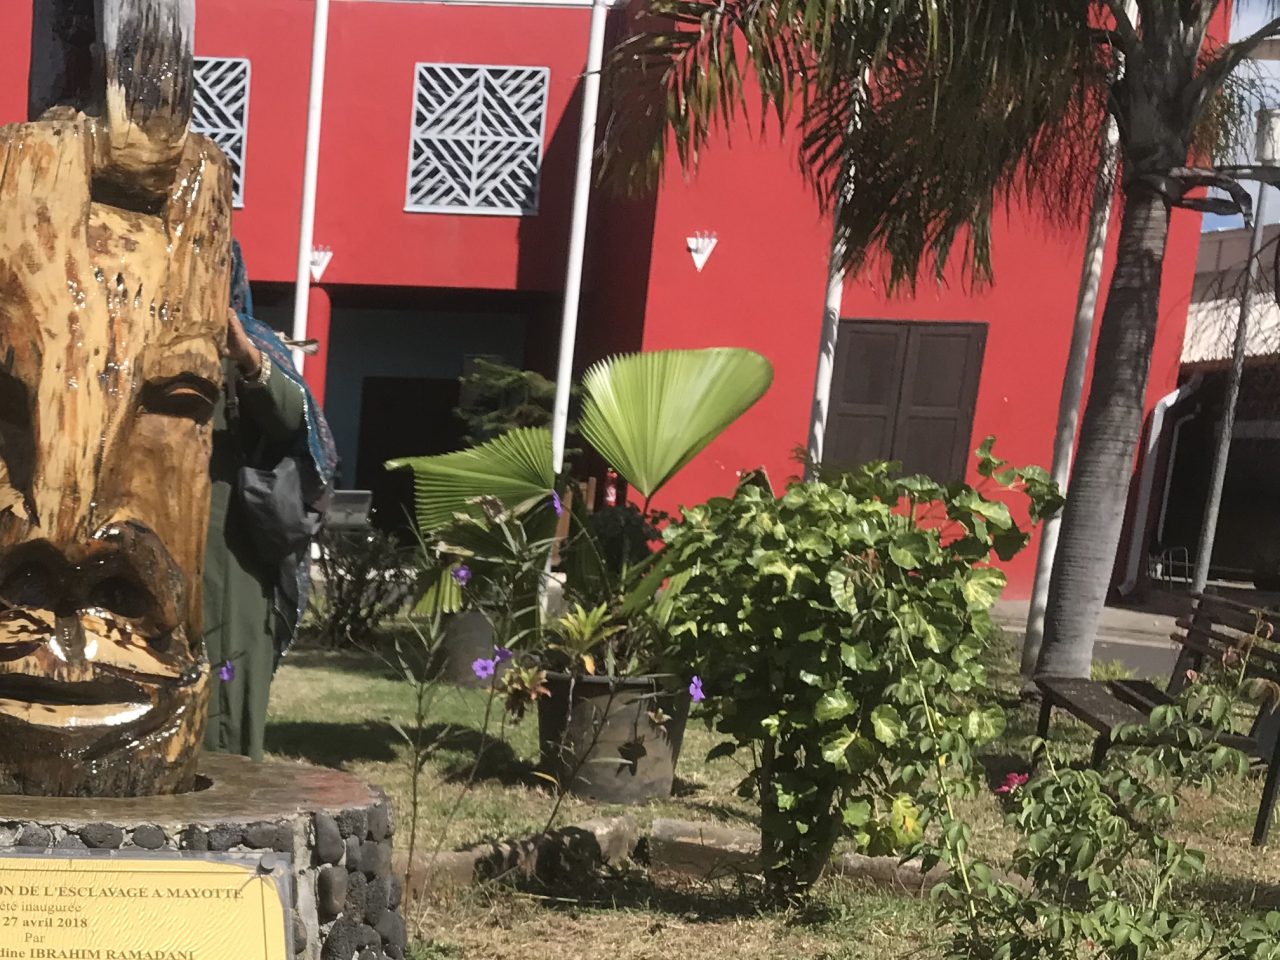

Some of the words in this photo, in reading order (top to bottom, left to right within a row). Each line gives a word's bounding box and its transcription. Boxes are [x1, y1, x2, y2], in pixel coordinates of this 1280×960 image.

[19, 885, 39, 896] DE
[44, 886, 148, 898] L'ESCLAVAGE
[152, 888, 162, 898] A
[167, 888, 243, 899] MAYOTTE
[0, 901, 17, 911] été
[22, 902, 82, 914] inaugurée
[3, 916, 18, 926] 27
[23, 917, 53, 927] avril
[57, 917, 88, 928] 2018
[25, 932, 46, 943] Par
[30, 948, 101, 960] IBRAHIM
[106, 950, 194, 960] RAMADANI
